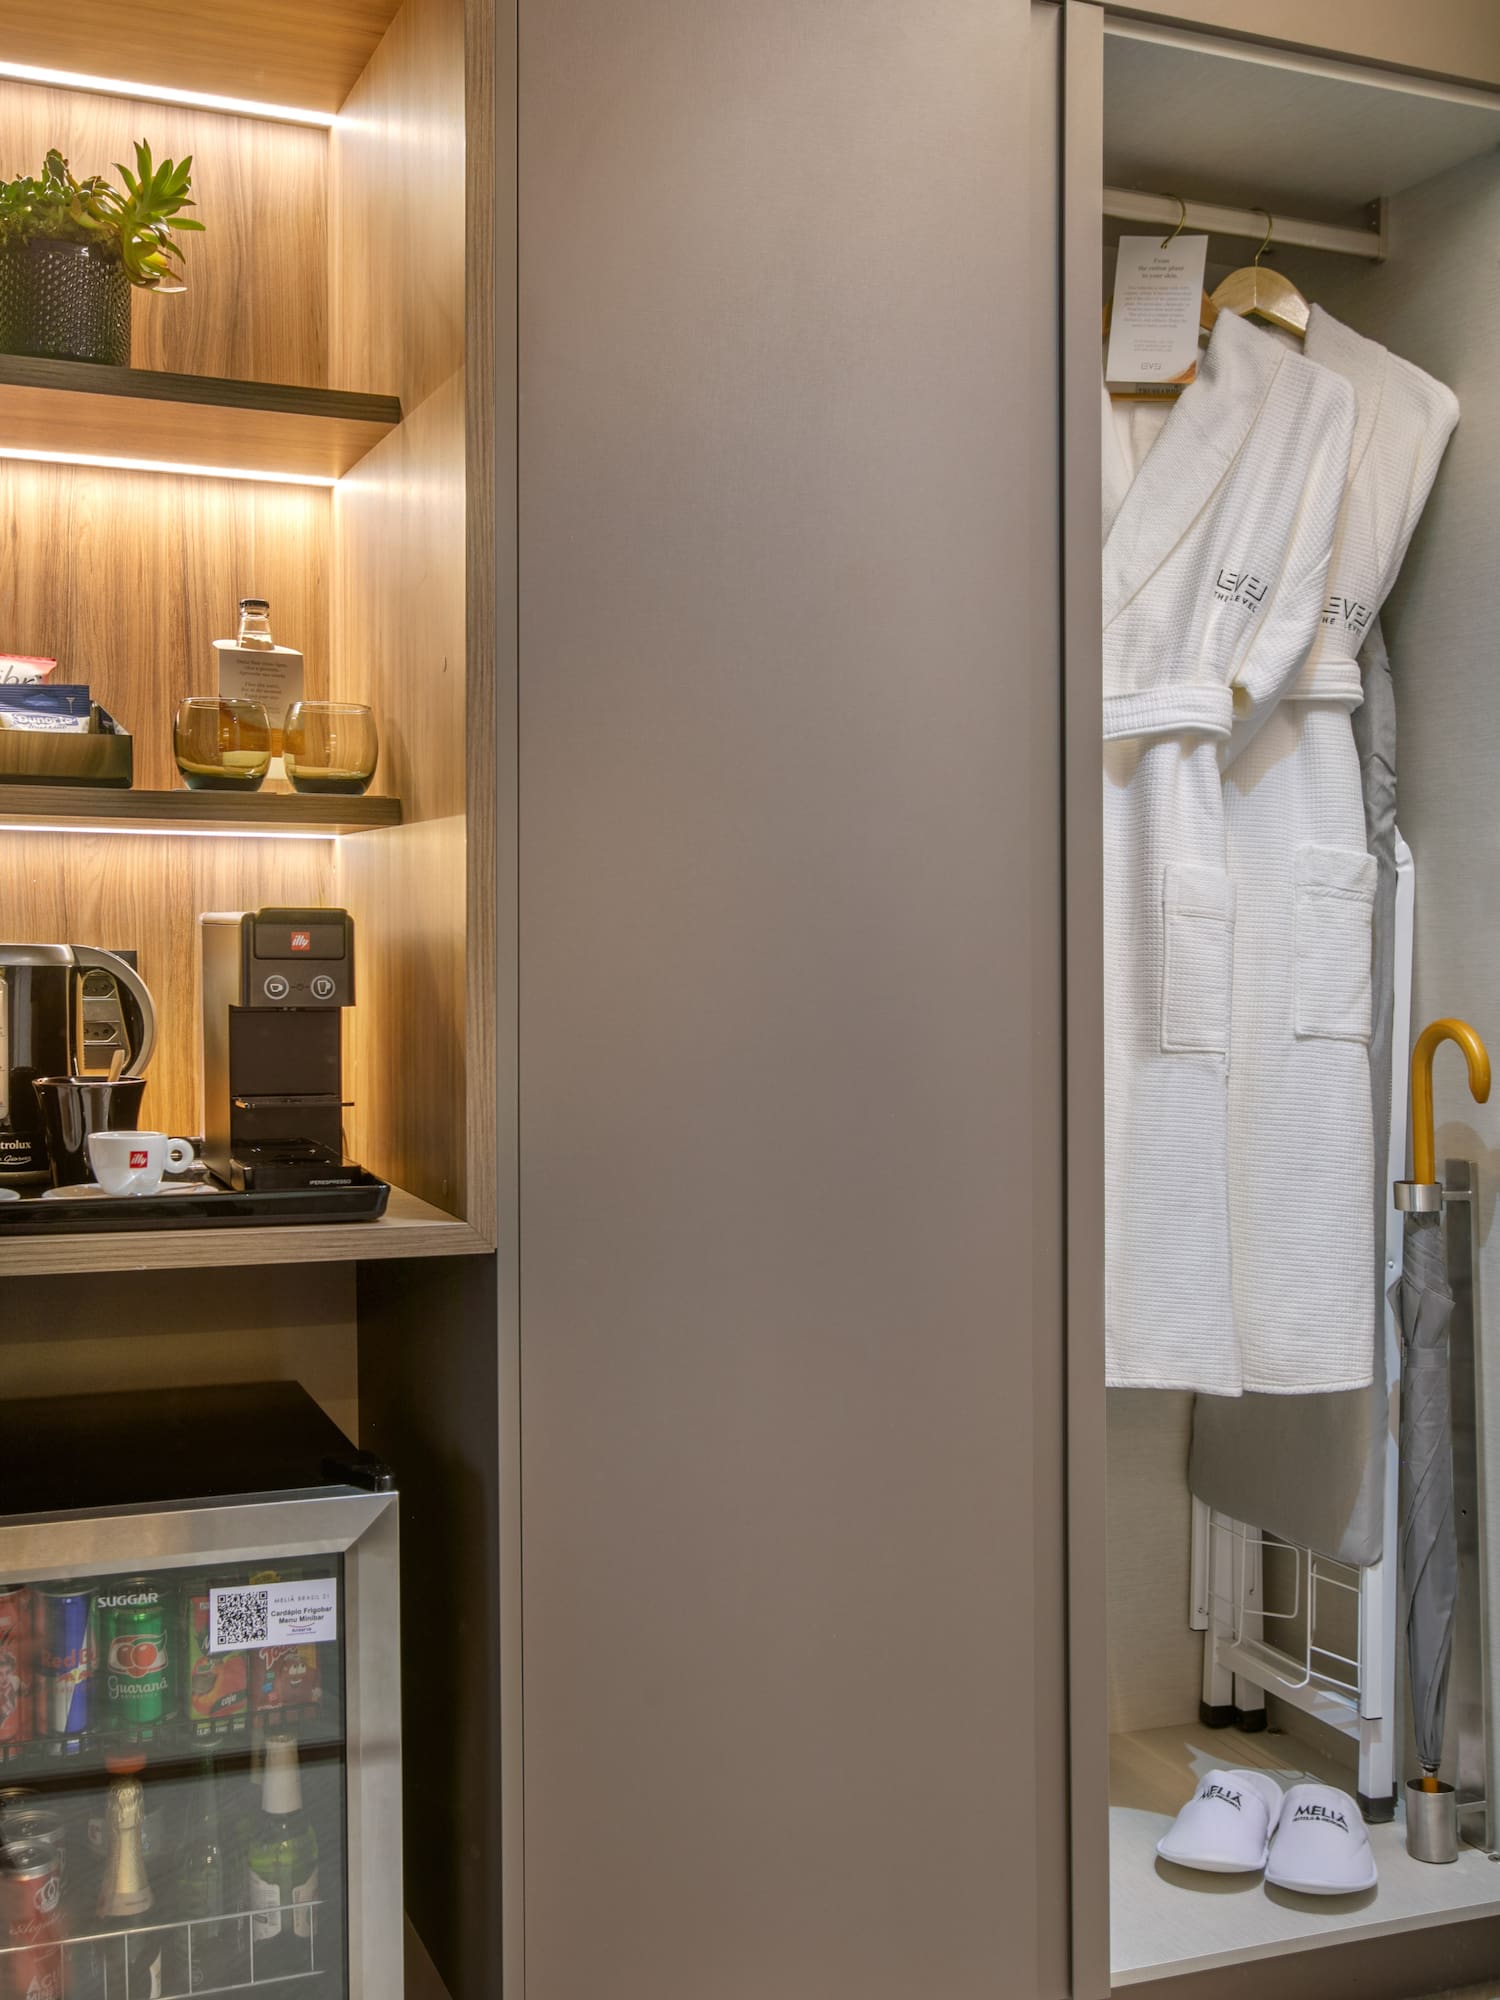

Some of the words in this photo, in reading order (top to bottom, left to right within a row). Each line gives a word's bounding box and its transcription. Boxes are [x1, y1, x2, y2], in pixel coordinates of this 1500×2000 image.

[1322, 617, 1336, 625] HE
[291, 934, 309, 950] illy
[0, 1139, 32, 1150] trolux
[130, 1152, 147, 1167] illy
[97, 1592, 159, 1608] SUGGAR
[270, 1607, 302, 1617] Cardápio
[303, 1605, 333, 1615] Frigobar
[299, 1614, 325, 1622] Minibar
